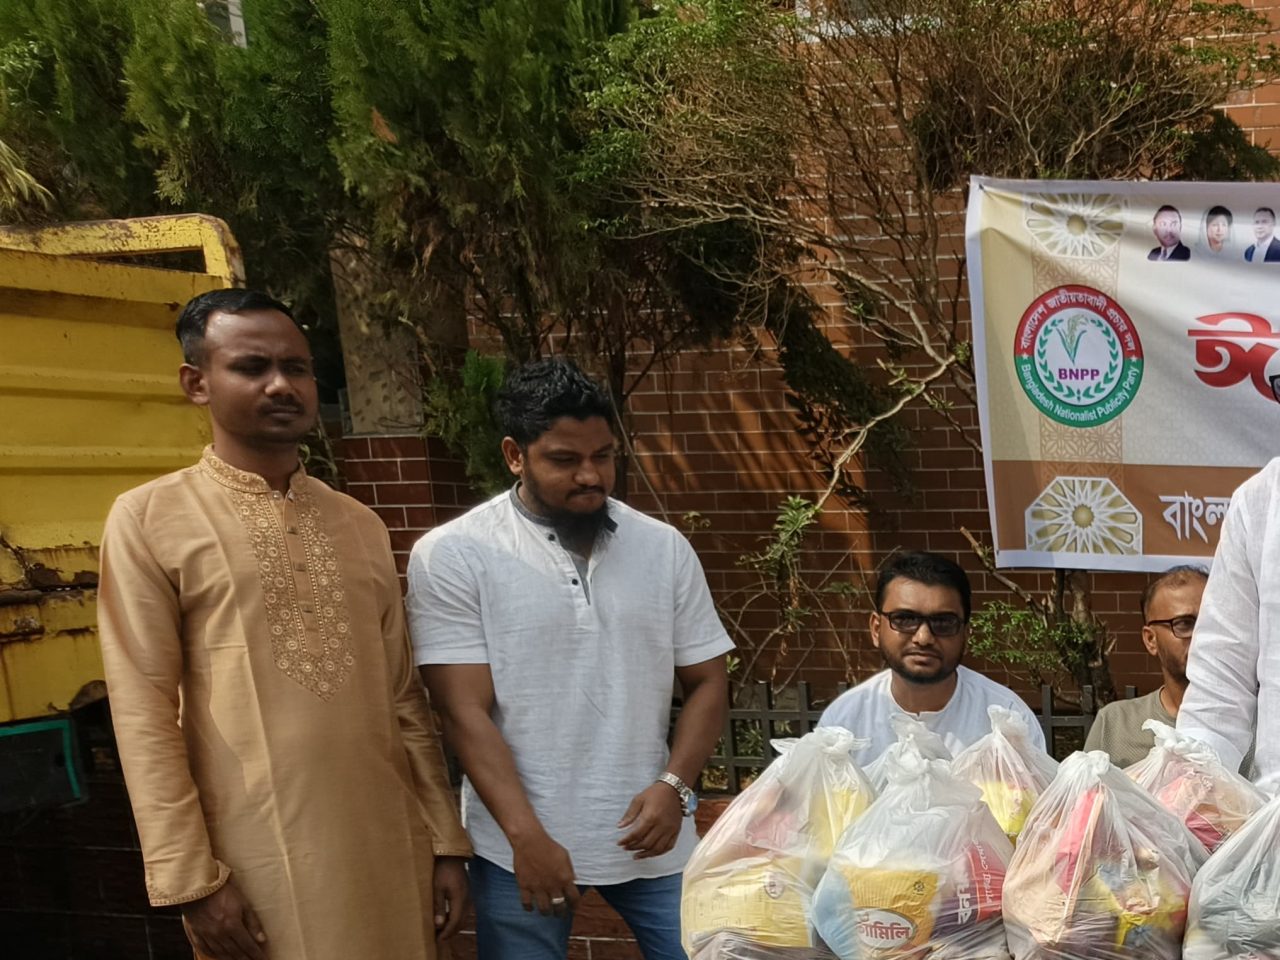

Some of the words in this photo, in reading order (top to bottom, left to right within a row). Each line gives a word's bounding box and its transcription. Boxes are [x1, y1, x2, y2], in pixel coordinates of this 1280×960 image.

[1020, 304, 1047, 349] বাংলাদেশ
[1021, 363, 1055, 411] Bangladesh
[1054, 404, 1098, 422] Nationalist
[1097, 387, 1130, 418] Publicity
[1123, 365, 1140, 391] Party
[1058, 368, 1100, 381] BNPP
